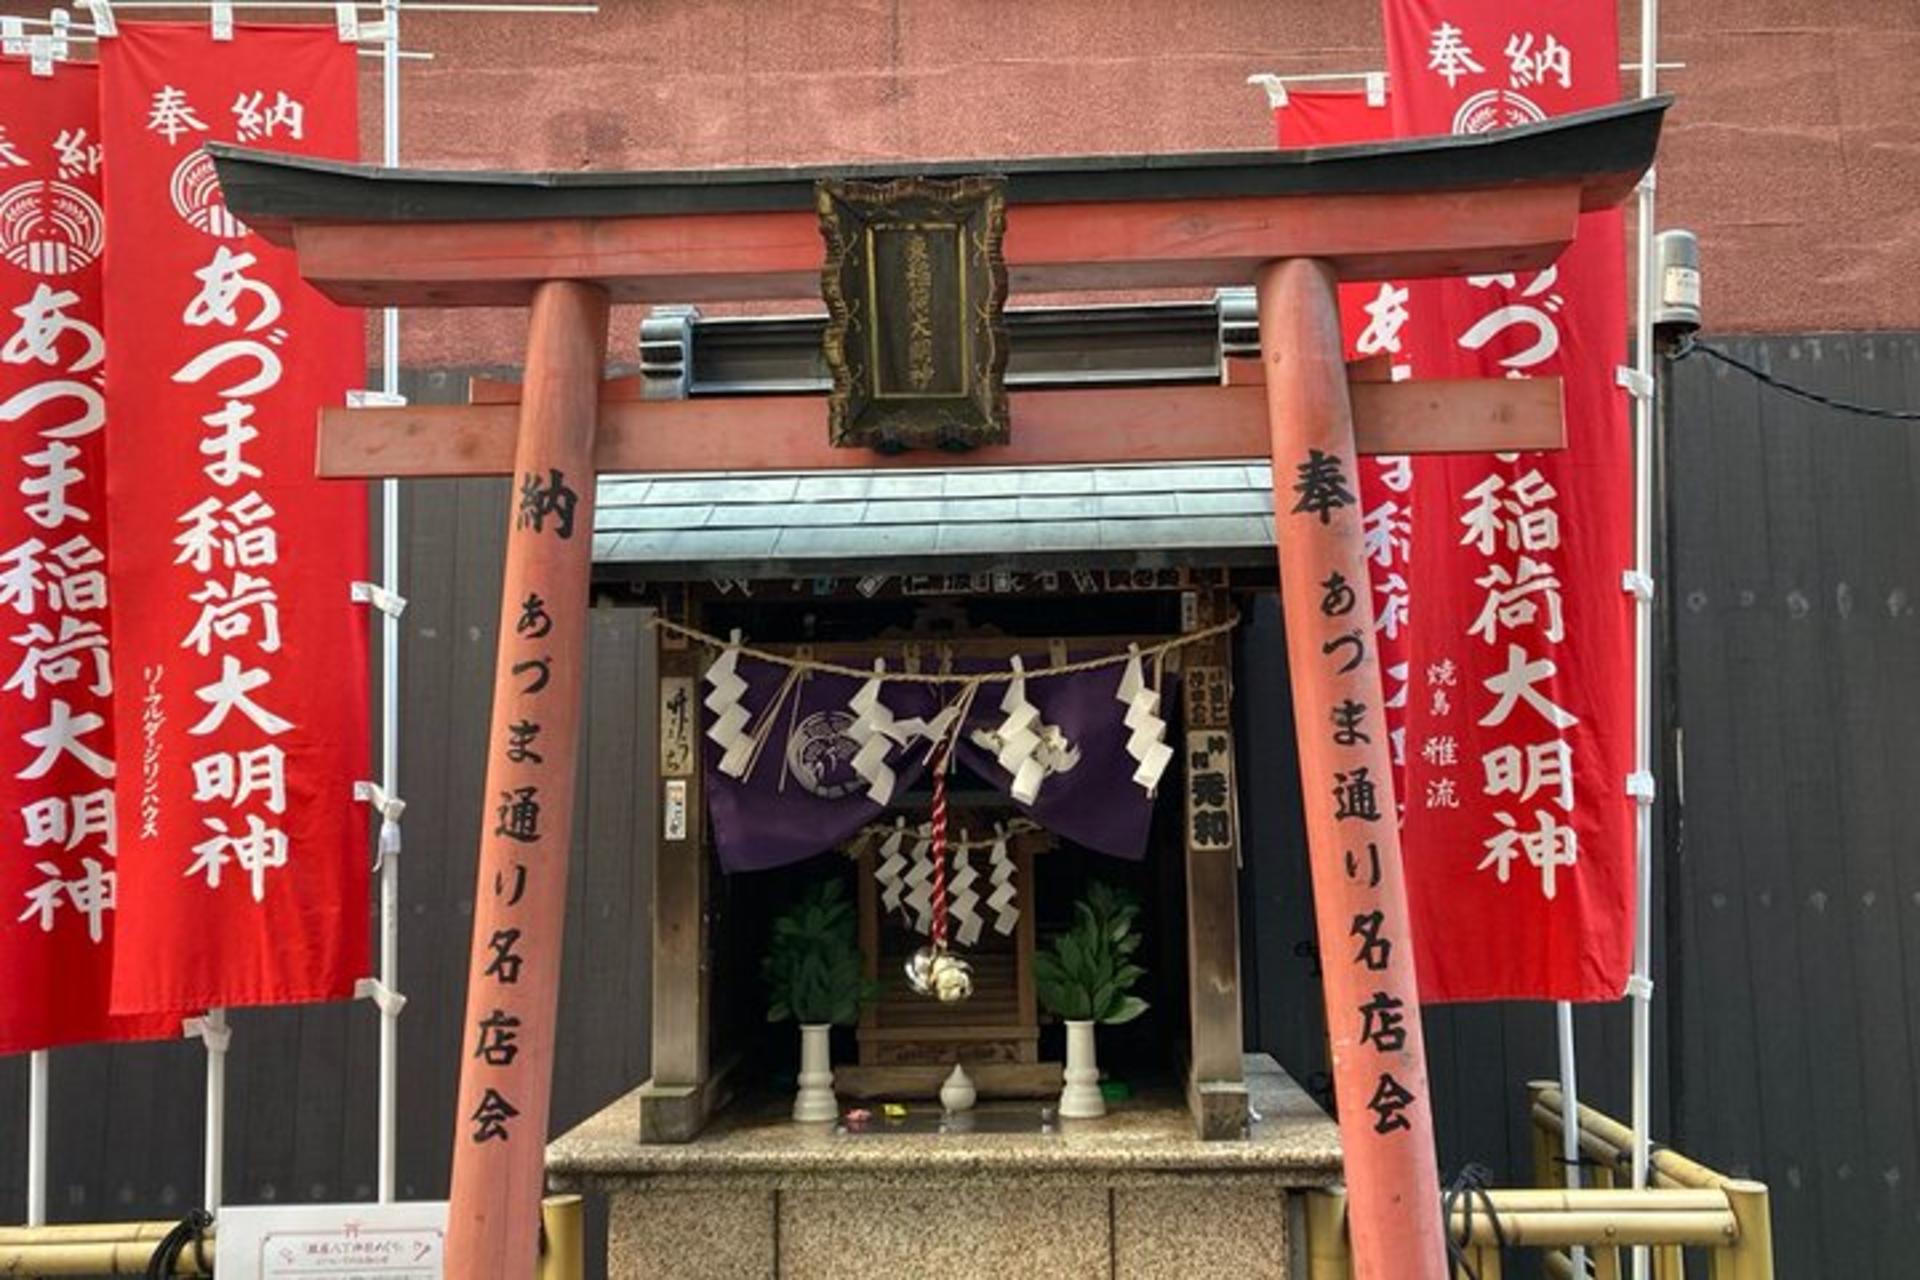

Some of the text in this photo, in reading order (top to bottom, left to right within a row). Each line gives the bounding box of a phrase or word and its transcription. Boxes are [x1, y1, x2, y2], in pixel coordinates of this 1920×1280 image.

[171, 245, 292, 902] あづま稲荷大明神
[469, 468, 577, 1144] 納 あづま通り名店会
[1291, 450, 1357, 526] 奉
[1458, 263, 1580, 901] づ稲荷大明神
[1318, 570, 1417, 1136] あづま通り名店会
